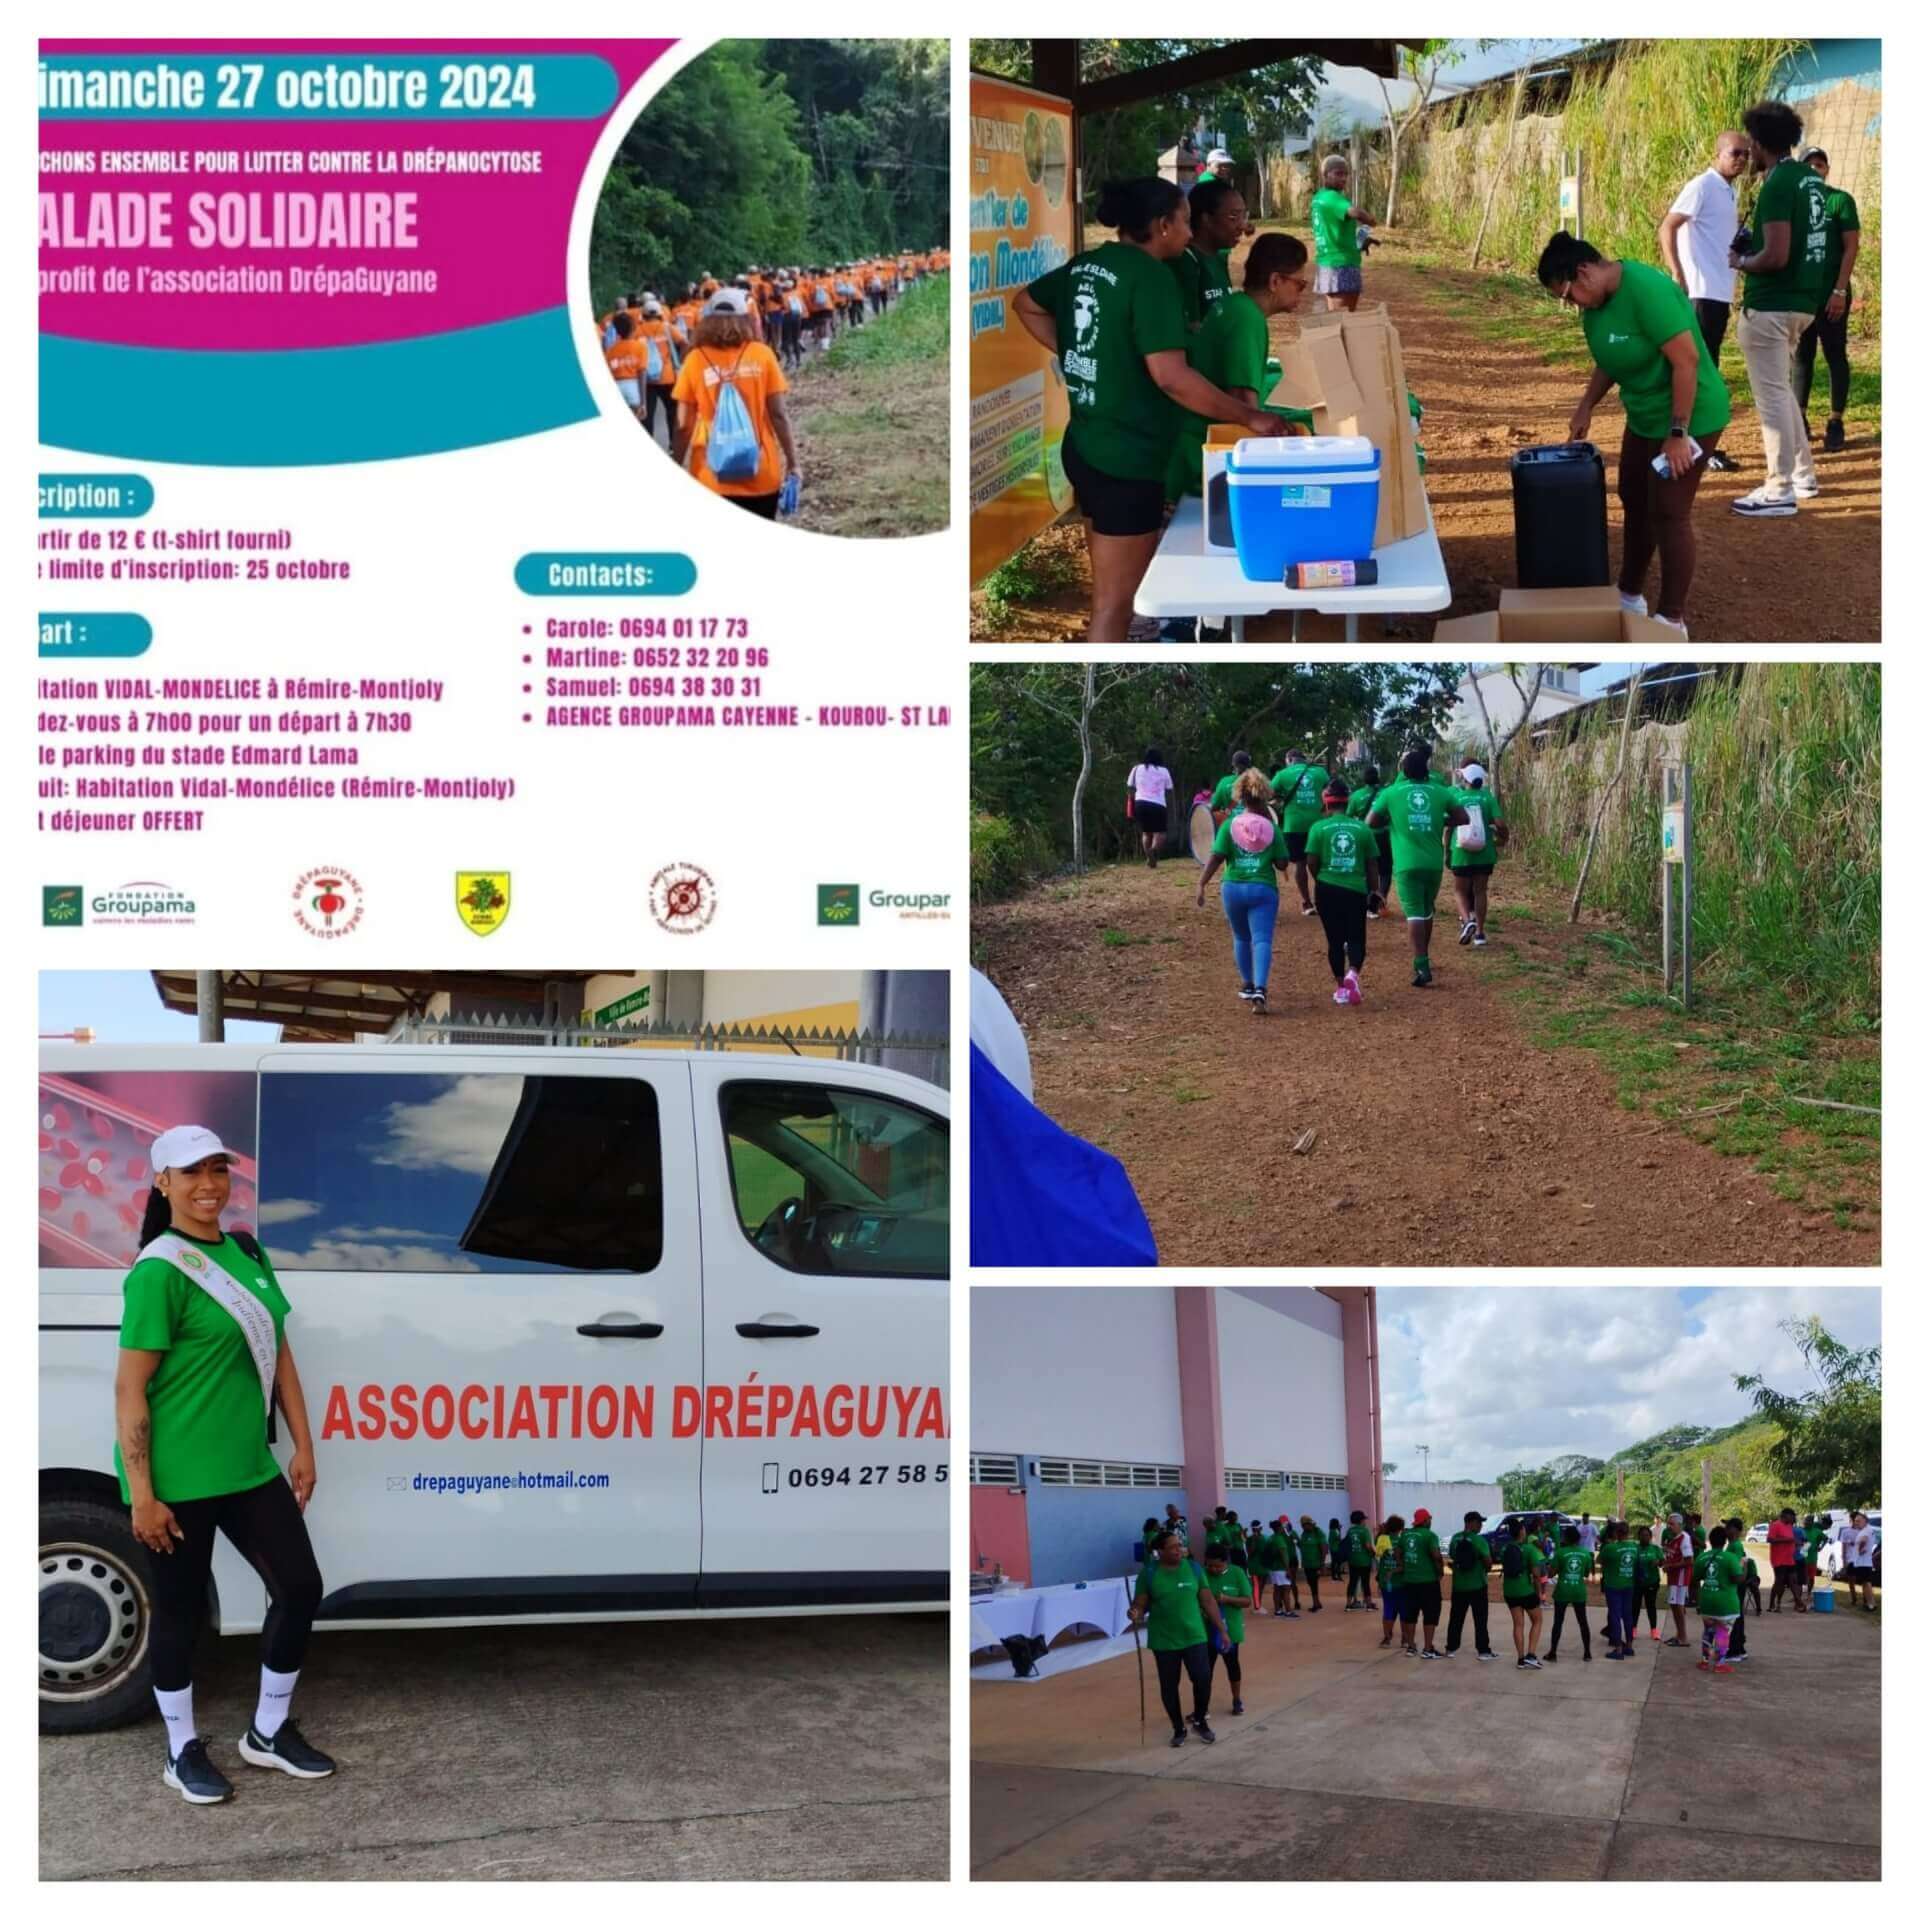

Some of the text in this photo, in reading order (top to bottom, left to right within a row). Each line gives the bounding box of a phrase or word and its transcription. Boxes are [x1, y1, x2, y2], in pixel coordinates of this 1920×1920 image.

[217, 64, 264, 108] 27
[277, 64, 427, 109] octobre
[439, 64, 536, 108] 2024
[101, 151, 188, 173] ENSEMBLE
[195, 151, 239, 173] POUR
[244, 151, 303, 173] LUTTER
[308, 151, 371, 173] CONTRE
[377, 151, 397, 172] LA
[403, 147, 541, 173] DRÉPANOCYTOSE
[190, 192, 418, 248] SOLIDAIRE
[1011, 190, 1028, 228] de
[103, 266, 130, 293] de
[137, 265, 283, 293] l'association
[290, 265, 437, 297] DrépaGuyane
[38, 529, 292, 552] rtir de 12 € (t-shirt fourni)
[49, 558, 105, 580] limite
[111, 558, 239, 582] d'inscription:
[246, 559, 269, 580] 25
[276, 559, 350, 580] octobre
[549, 562, 653, 588] Contacts:
[38, 620, 73, 644] art
[546, 617, 748, 639] Carole: 0694 01 17 73
[546, 646, 769, 668] Martine: 0652 32 20 96
[104, 679, 261, 700] VIDAL-MONDELICE
[267, 677, 279, 700] à
[285, 677, 444, 702] Rémire-Montjoly
[546, 676, 761, 697] Samuel: 0694 38 30 31
[38, 710, 412, 735] dez-vous à 7h00 pour un départ à 7h30
[546, 706, 612, 727] AGENCE
[618, 706, 715, 727] GROUPAMA
[722, 706, 798, 727] CAYENNE
[819, 706, 894, 727] KOUROU-
[901, 706, 922, 726] ST
[928, 706, 950, 726] LA
[38, 744, 359, 768] le parking du stade Edmard Lama
[76, 777, 174, 798] Habitation
[180, 776, 335, 798] Vidal-Mondélice
[341, 776, 515, 801] (Rémire-Montjoly)
[50, 809, 135, 833] déjeuner
[142, 810, 204, 831] OFFERT
[92, 896, 196, 917] Groupama
[321, 1371, 950, 1440] ASSOCIATION DRÉPAGUYA
[788, 1463, 949, 1488] 0694 27 58 5
